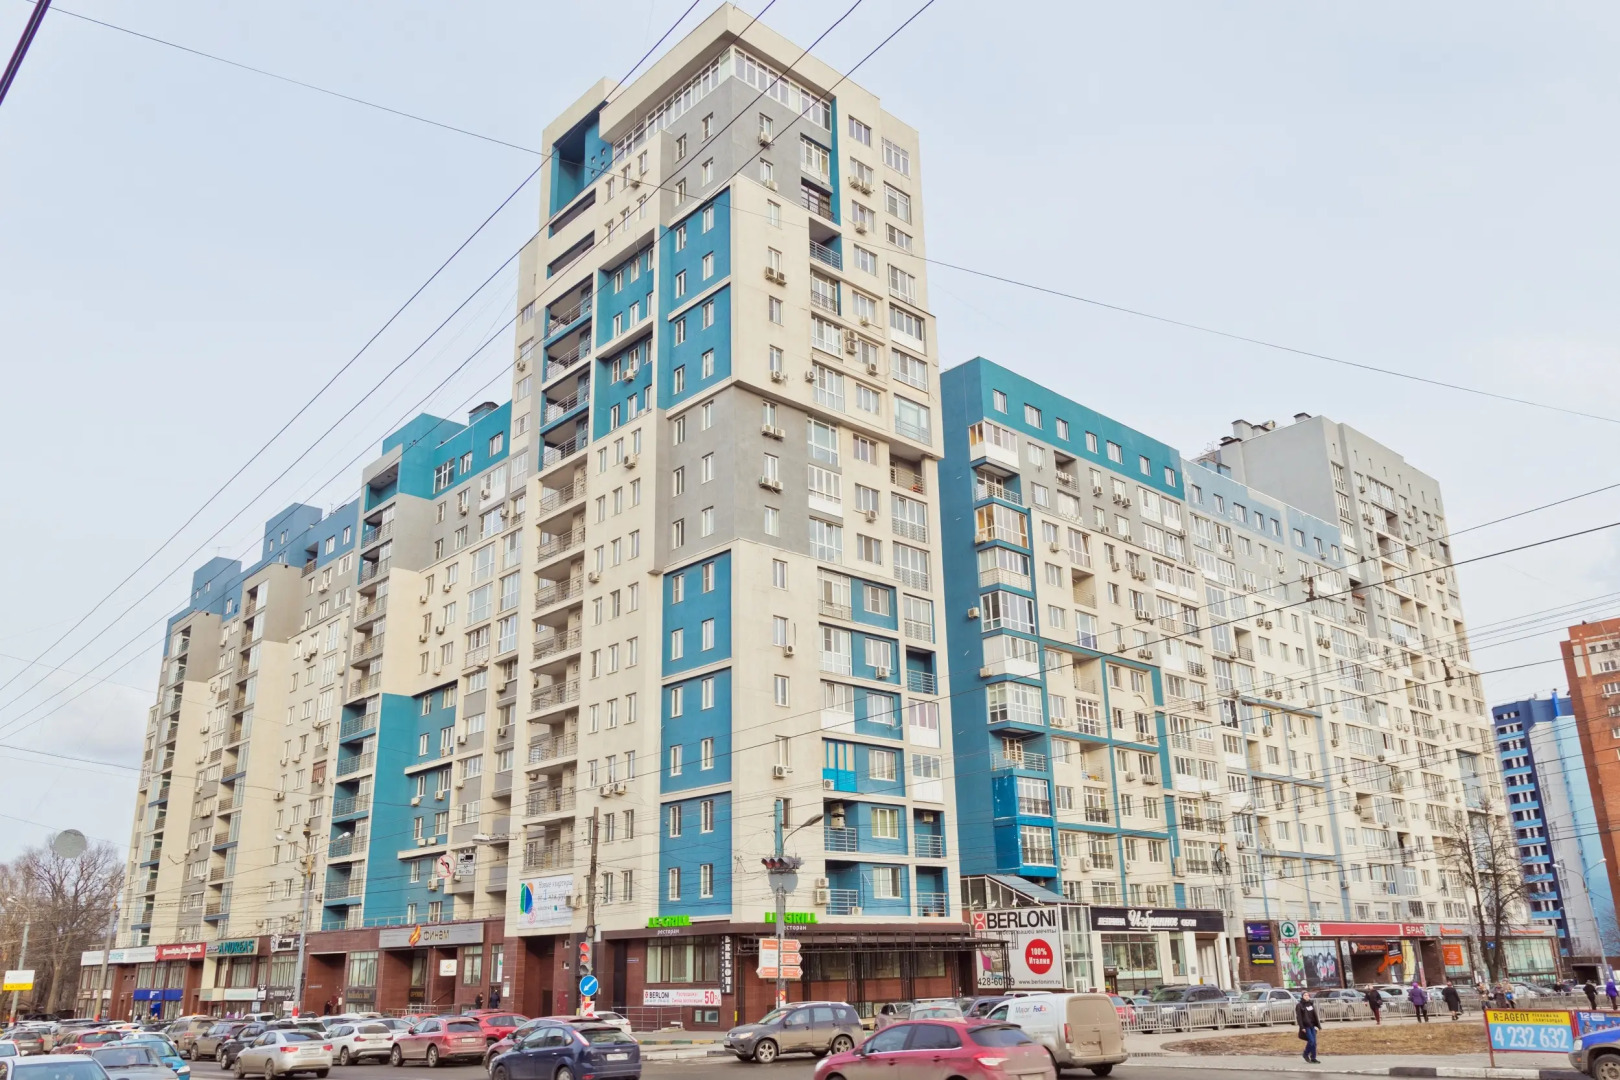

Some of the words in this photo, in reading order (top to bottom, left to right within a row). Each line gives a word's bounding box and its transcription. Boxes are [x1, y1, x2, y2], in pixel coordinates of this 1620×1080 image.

[784, 912, 819, 924] GRILL
[986, 910, 1056, 929] BERLONI
[1127, 909, 1179, 933] Избранное
[1298, 924, 1310, 934] AR
[1405, 925, 1425, 935] SPAR
[724, 935, 732, 993] BERLONI
[1029, 957, 1050, 965] Италия
[649, 991, 670, 999] BERLONI
[1493, 1012, 1529, 1022] REAGENT
[1494, 1026, 1504, 1047] 4
[1506, 1026, 1537, 1048] 232
[1540, 1027, 1569, 1049] 632
